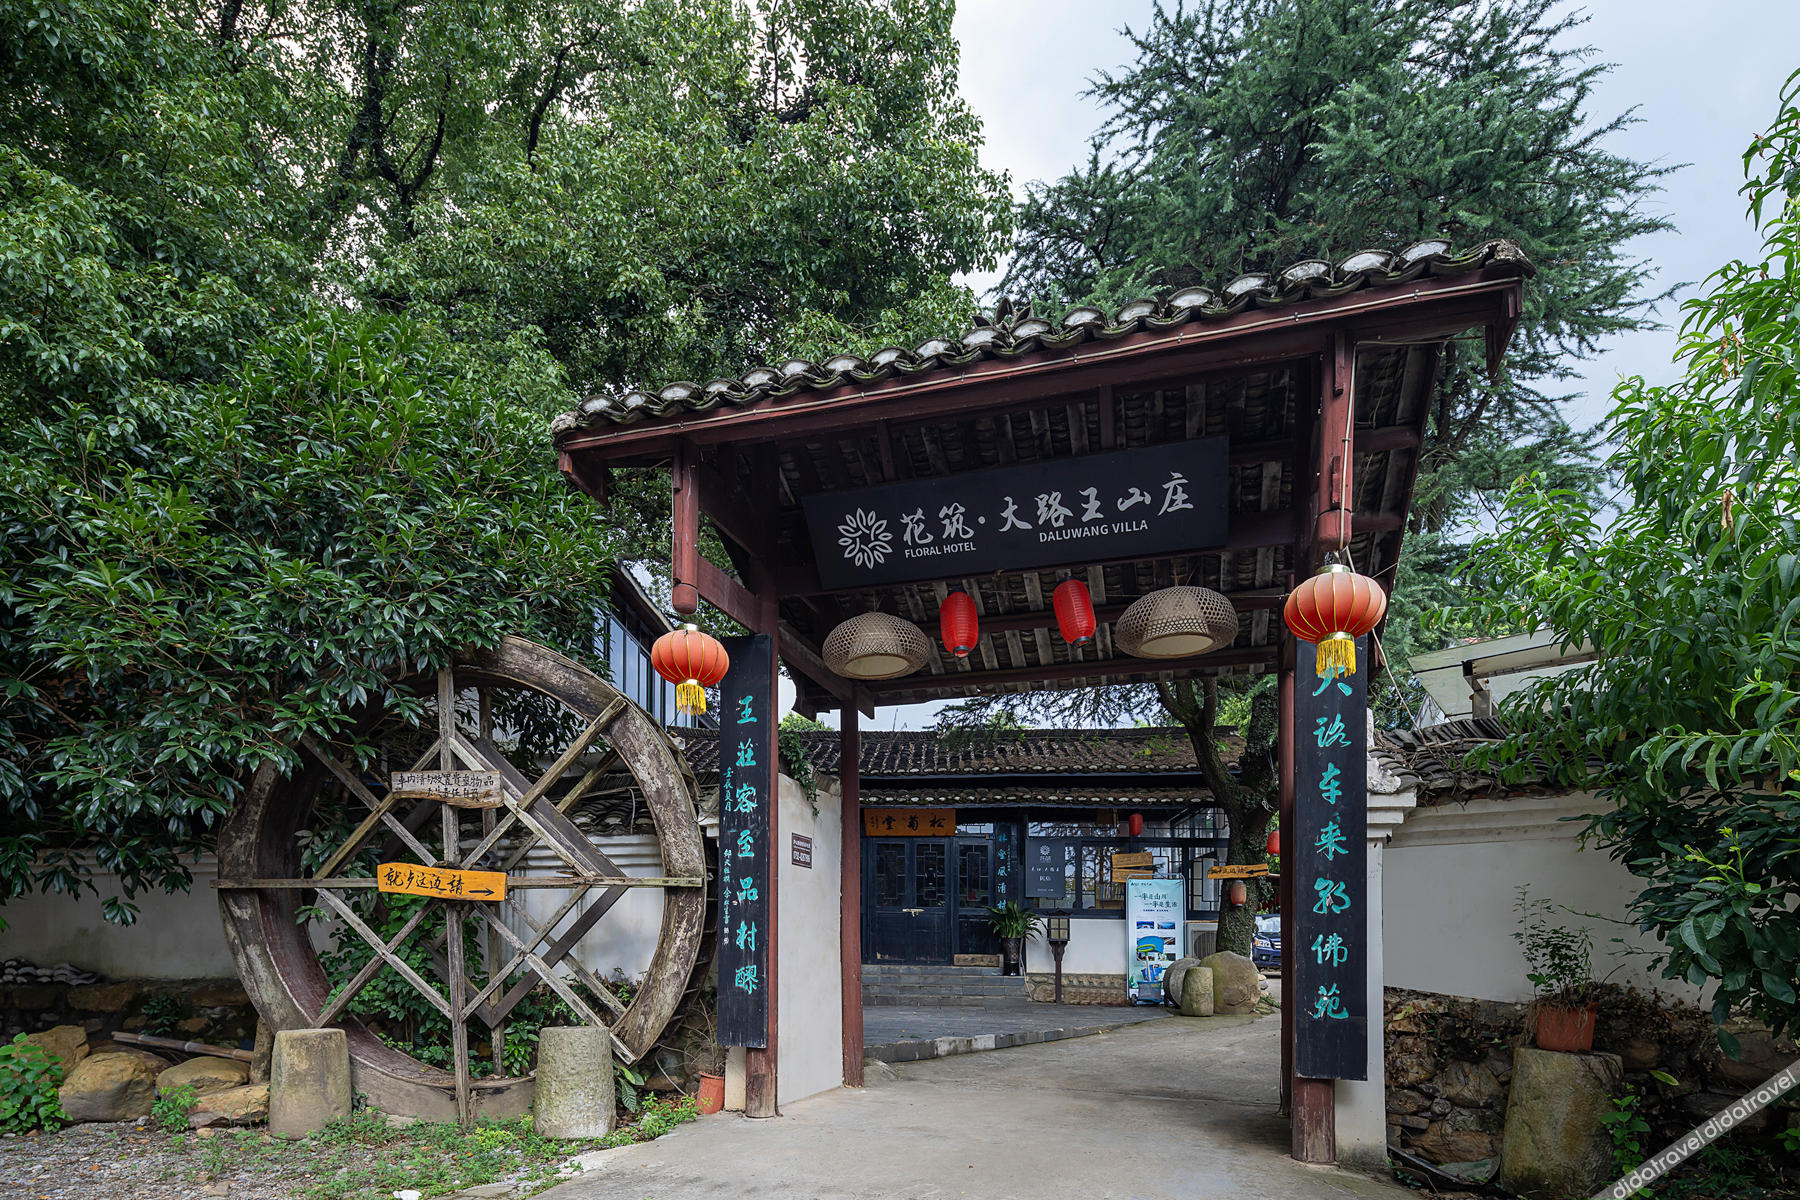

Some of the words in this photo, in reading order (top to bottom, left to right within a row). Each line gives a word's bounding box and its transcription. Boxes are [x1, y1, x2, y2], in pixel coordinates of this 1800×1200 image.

[1039, 524, 1109, 543] DALUWANG
[1111, 519, 1149, 534] VILLA
[904, 545, 942, 559] FLORAL
[943, 541, 977, 554] HOTEL
